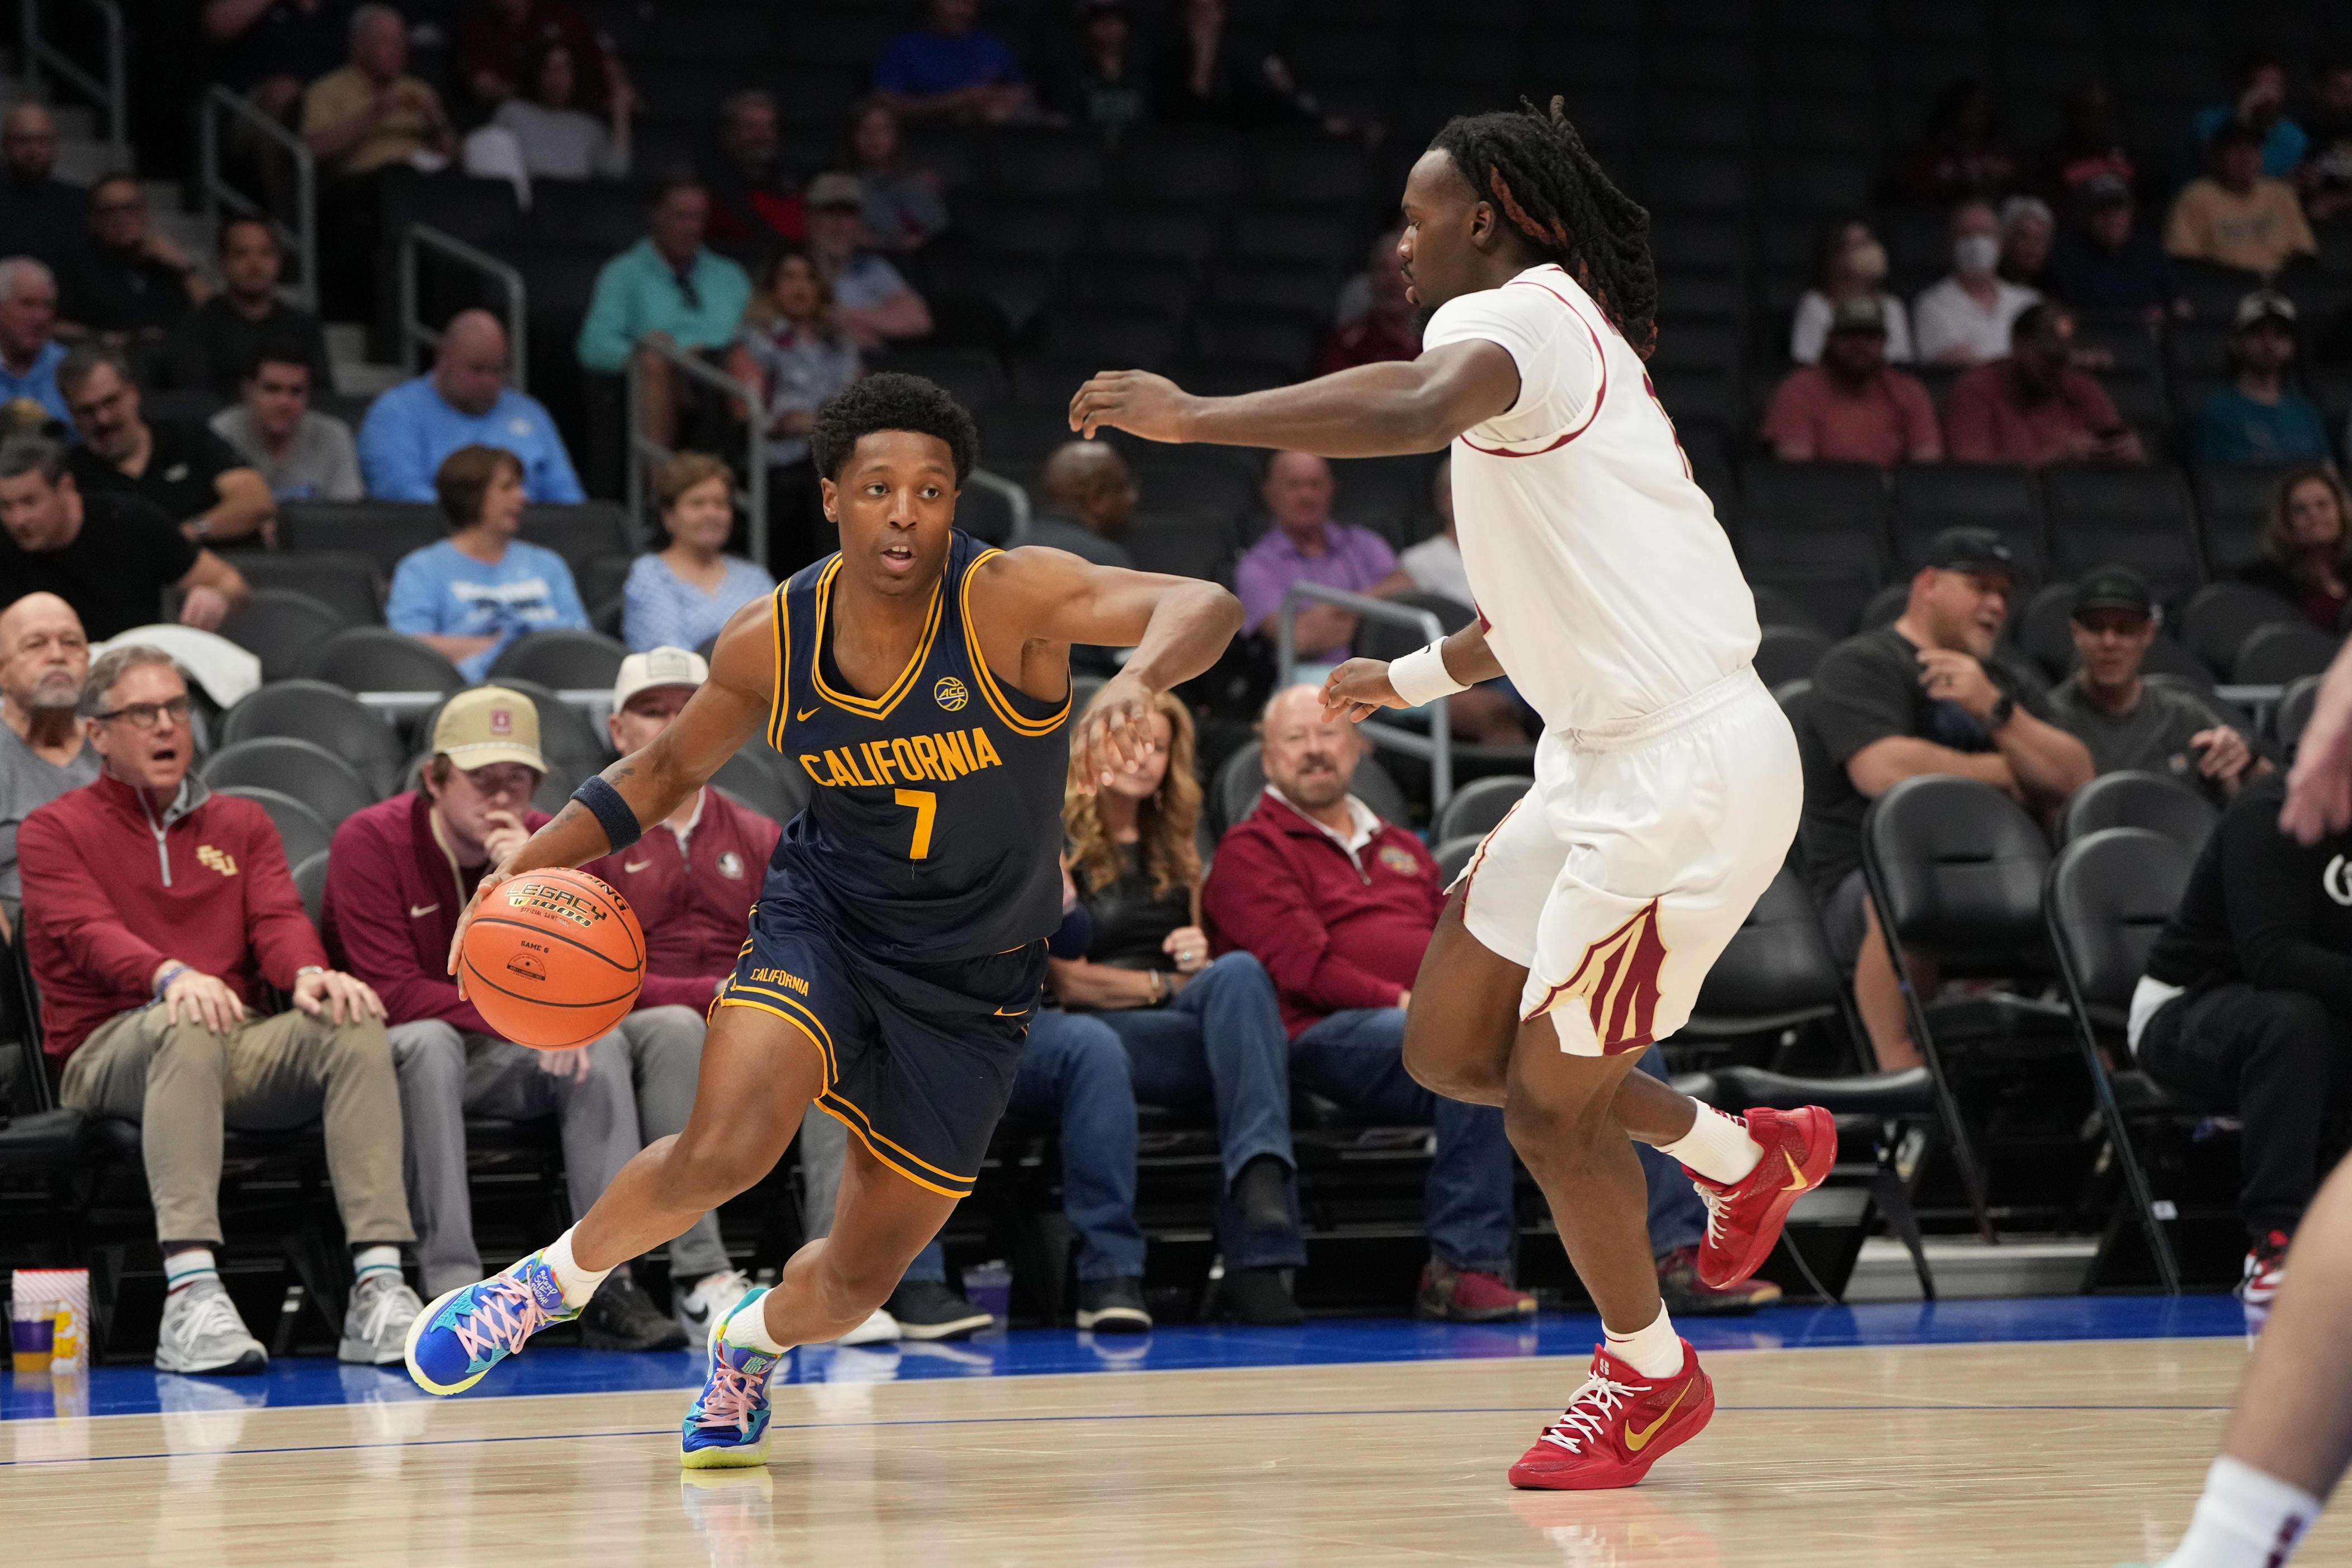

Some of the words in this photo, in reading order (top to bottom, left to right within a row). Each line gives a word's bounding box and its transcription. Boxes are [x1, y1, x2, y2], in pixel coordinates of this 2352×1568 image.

[938, 686, 966, 698] ACC
[799, 727, 1002, 787] CALIFORNIA
[895, 788, 936, 859] 7
[196, 844, 239, 877] FSU
[505, 883, 607, 921] LEGACY
[530, 898, 592, 927] 1000
[521, 940, 542, 951] GAME
[750, 968, 809, 997] CALIFORNIA
